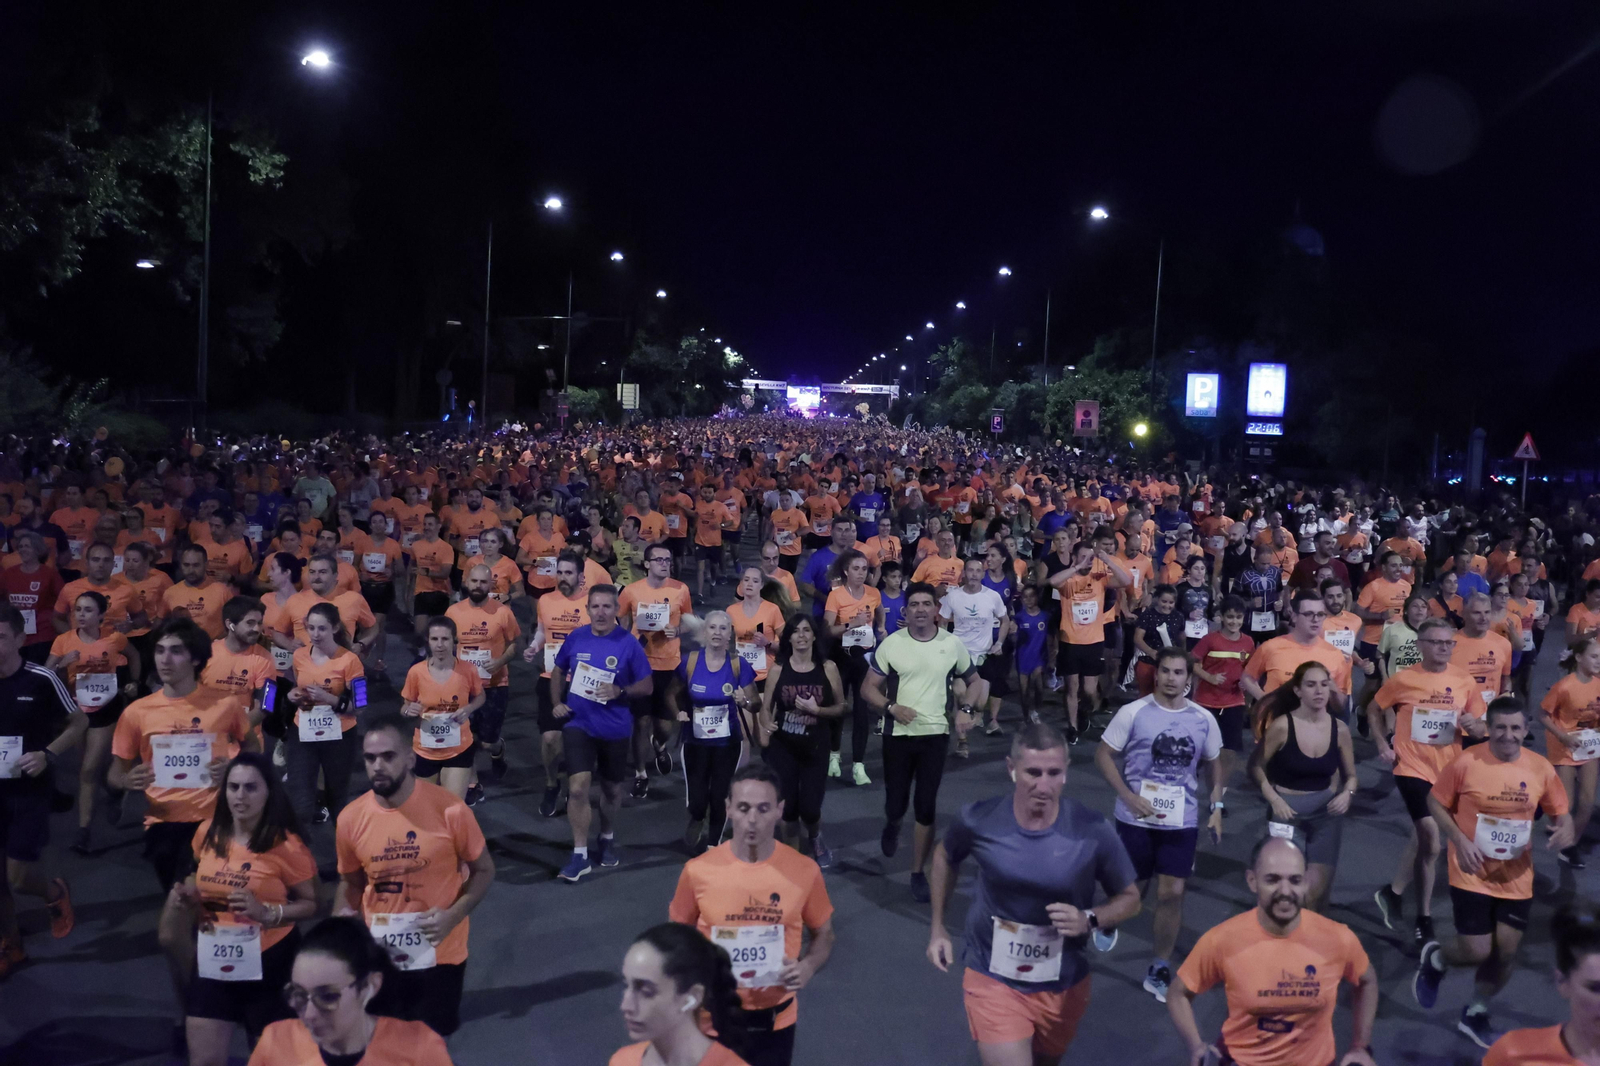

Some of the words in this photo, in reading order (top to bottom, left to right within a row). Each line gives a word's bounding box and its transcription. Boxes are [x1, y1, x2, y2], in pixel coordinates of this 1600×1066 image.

[1194, 377, 1213, 402] P
[994, 416, 1001, 424] P
[1248, 422, 1280, 432] 22:06
[308, 717, 333, 727] 11152
[701, 716, 723, 725] 17384
[1422, 720, 1449, 730] 20557
[431, 726, 450, 734] 5299
[164, 755, 200, 767] 20939
[1152, 798, 1175, 809] 8905
[1490, 831, 1517, 844] 9028
[384, 845, 420, 854] NOCTURNA
[371, 853, 401, 862] SEVILLA
[200, 875, 228, 886] SEVILLA
[743, 906, 783, 915] NOCTURNA
[382, 932, 421, 947] 12753
[214, 945, 243, 958] 2879
[732, 946, 766, 962] 2693
[1008, 940, 1049, 958] 17064
